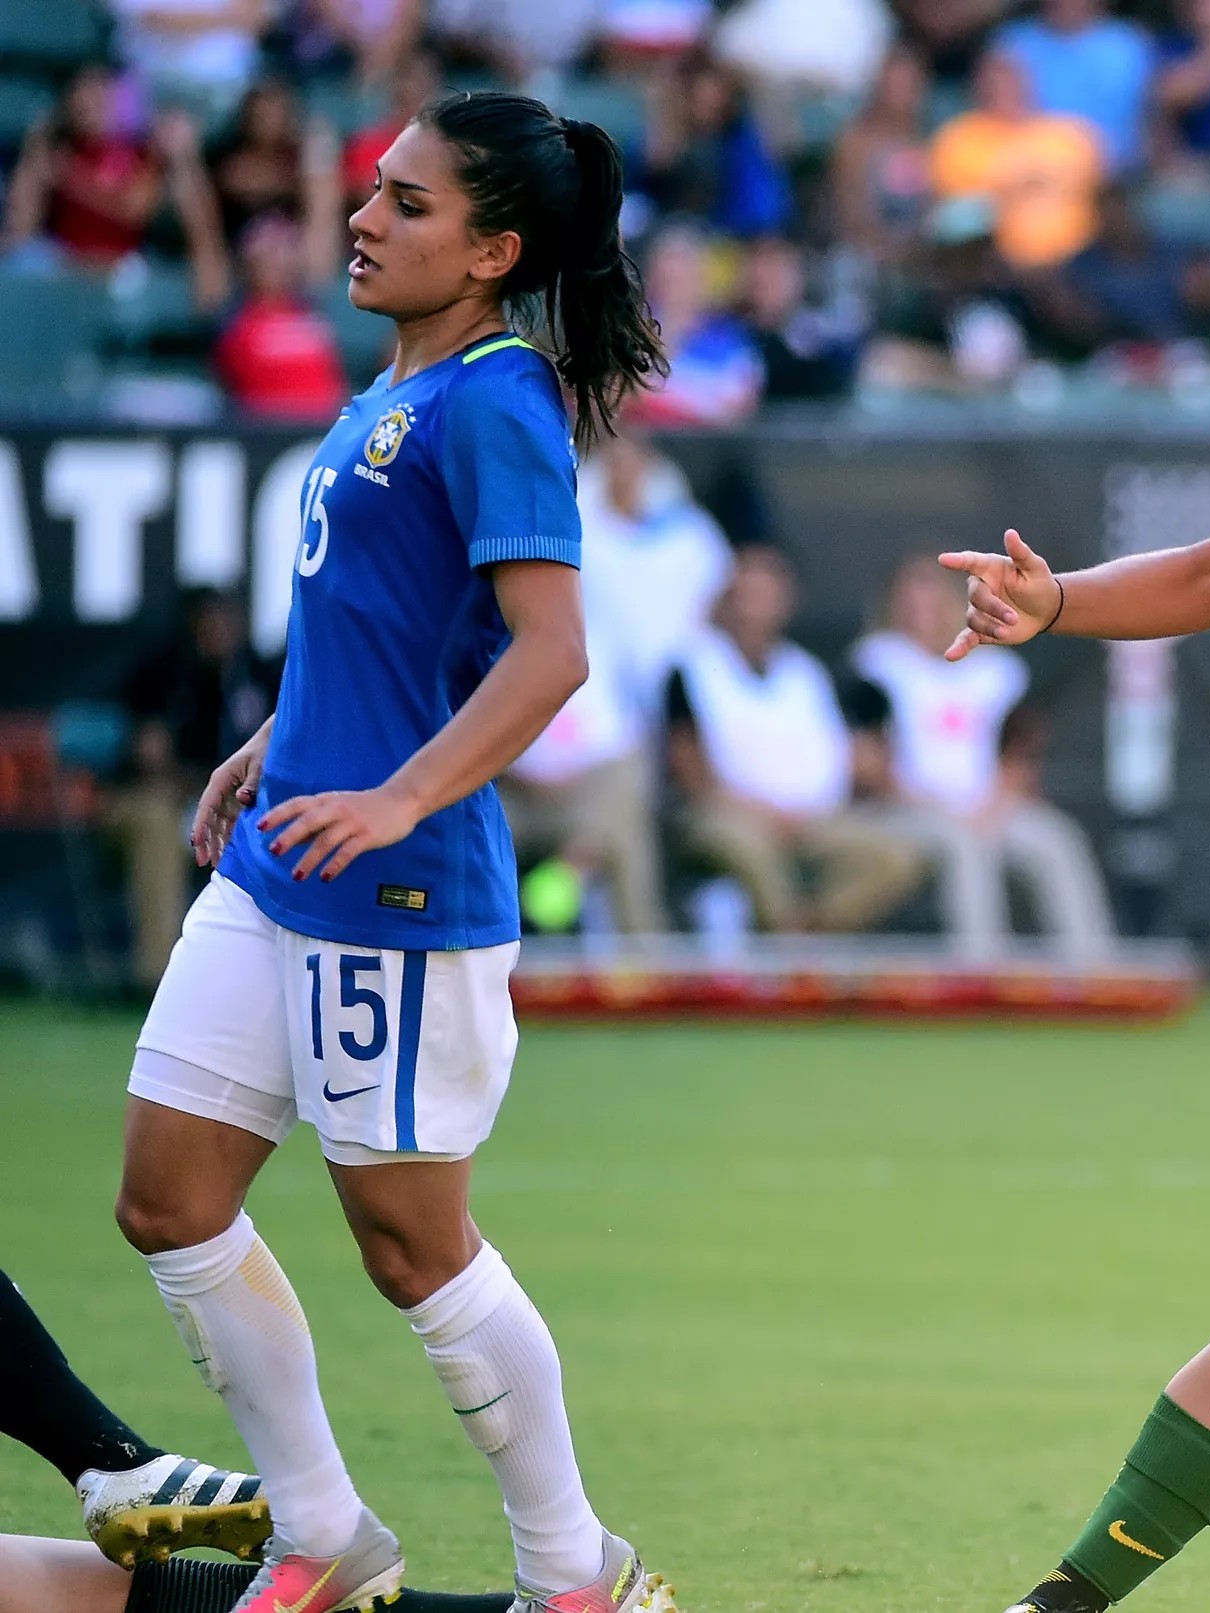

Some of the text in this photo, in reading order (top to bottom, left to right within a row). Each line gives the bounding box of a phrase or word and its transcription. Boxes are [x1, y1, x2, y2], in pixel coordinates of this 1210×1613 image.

[295, 465, 338, 578] 15
[353, 463, 391, 488] BRASIL
[306, 953, 389, 1062] 15
